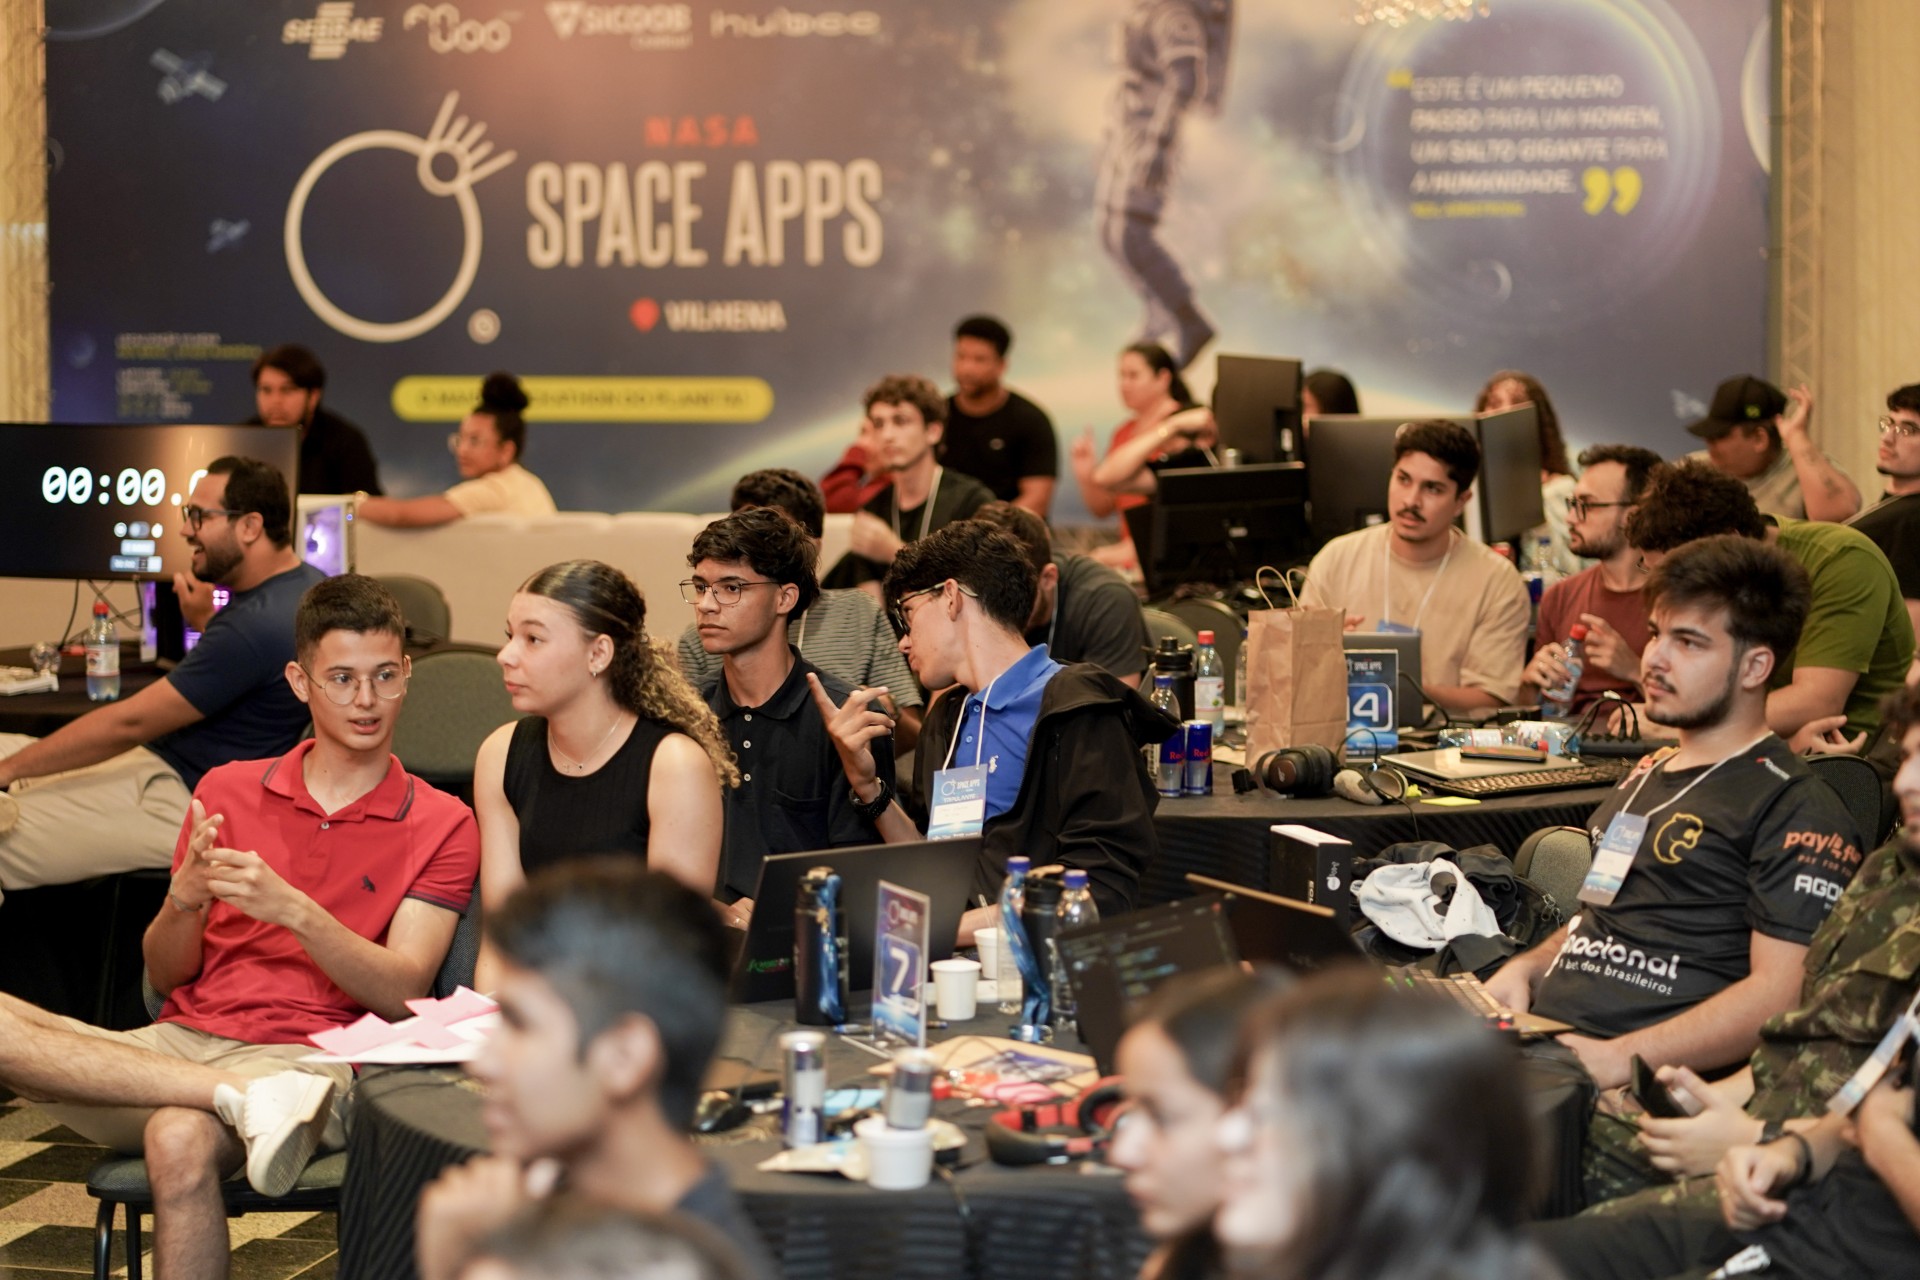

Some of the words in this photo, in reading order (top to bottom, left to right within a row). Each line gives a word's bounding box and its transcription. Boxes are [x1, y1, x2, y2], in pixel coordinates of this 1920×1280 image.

[644, 116, 758, 147] NASA
[526, 160, 709, 269] SPACE
[723, 158, 884, 268] APPS
[889, 946, 911, 993] 7
